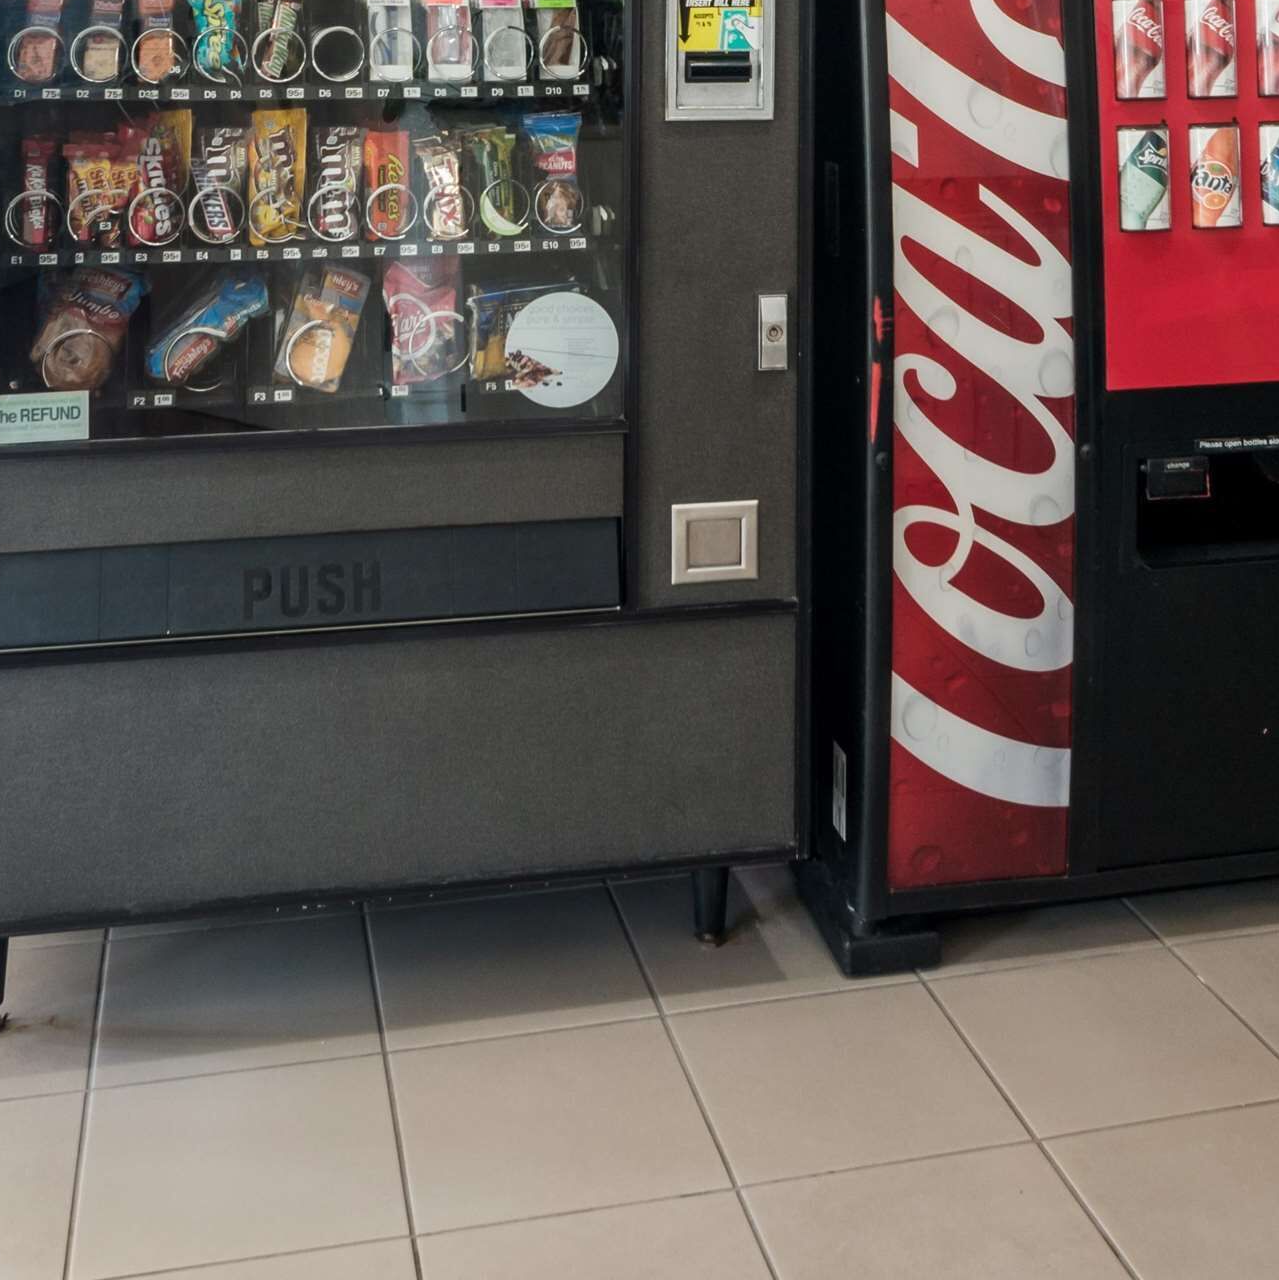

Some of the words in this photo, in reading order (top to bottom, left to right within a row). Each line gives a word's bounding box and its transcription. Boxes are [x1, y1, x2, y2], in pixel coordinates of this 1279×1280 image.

[14, 90, 26, 98] D1
[77, 90, 89, 98] D2
[320, 89, 332, 97] D6
[378, 89, 389, 97] D7
[435, 89, 446, 97] D8
[492, 88, 503, 96] D9
[546, 87, 562, 95] D10
[543, 241, 558, 249] E10
[11, 256, 22, 264] E1
[197, 252, 208, 260] E4
[70, 289, 120, 320] Jumbo
[134, 397, 145, 405] F2
[255, 393, 265, 401] F3
[20, 405, 81, 422] REFUND
[1200, 440, 1222, 449] Please
[1224, 440, 1241, 449] open
[1244, 438, 1267, 447] bottles
[242, 561, 383, 620] PUSH
